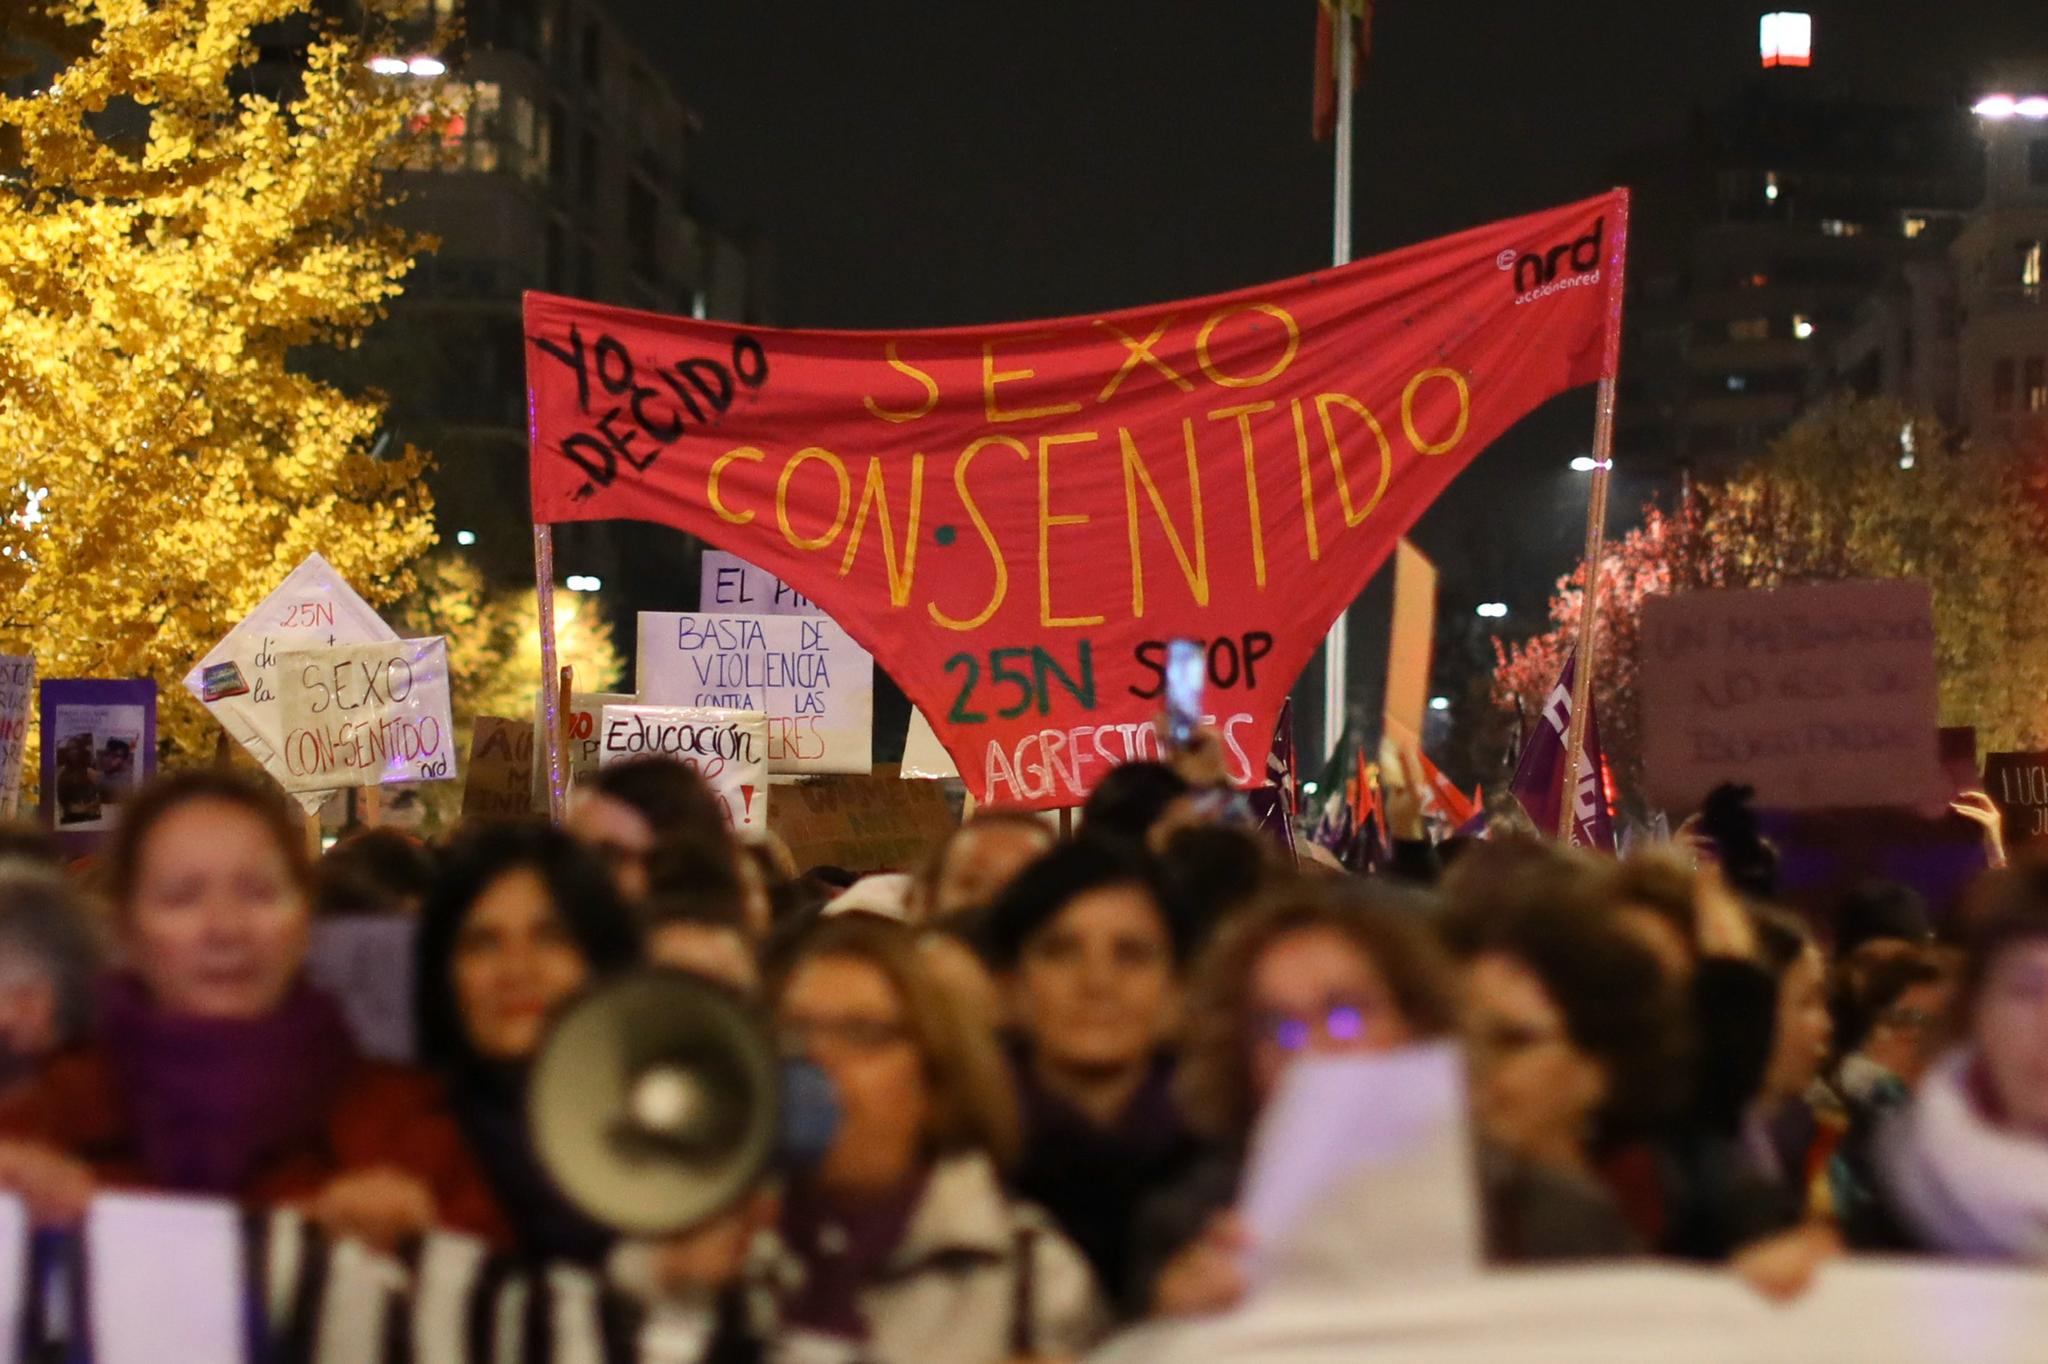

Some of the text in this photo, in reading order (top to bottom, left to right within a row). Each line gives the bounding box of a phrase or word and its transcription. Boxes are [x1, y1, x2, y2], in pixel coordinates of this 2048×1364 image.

[527, 322, 635, 416] YO
[862, 303, 1300, 423] SEXO
[559, 333, 769, 499] DECIDO
[715, 567, 754, 604] EL
[279, 601, 336, 628] 25N
[678, 616, 830, 652] BASTA DE
[253, 677, 276, 703] la
[302, 656, 413, 713] SEXO
[692, 651, 831, 689] VIOLENCIA
[943, 631, 1273, 724] 25N SOP
[794, 691, 826, 714] LAS
[606, 714, 762, 765] Educación
